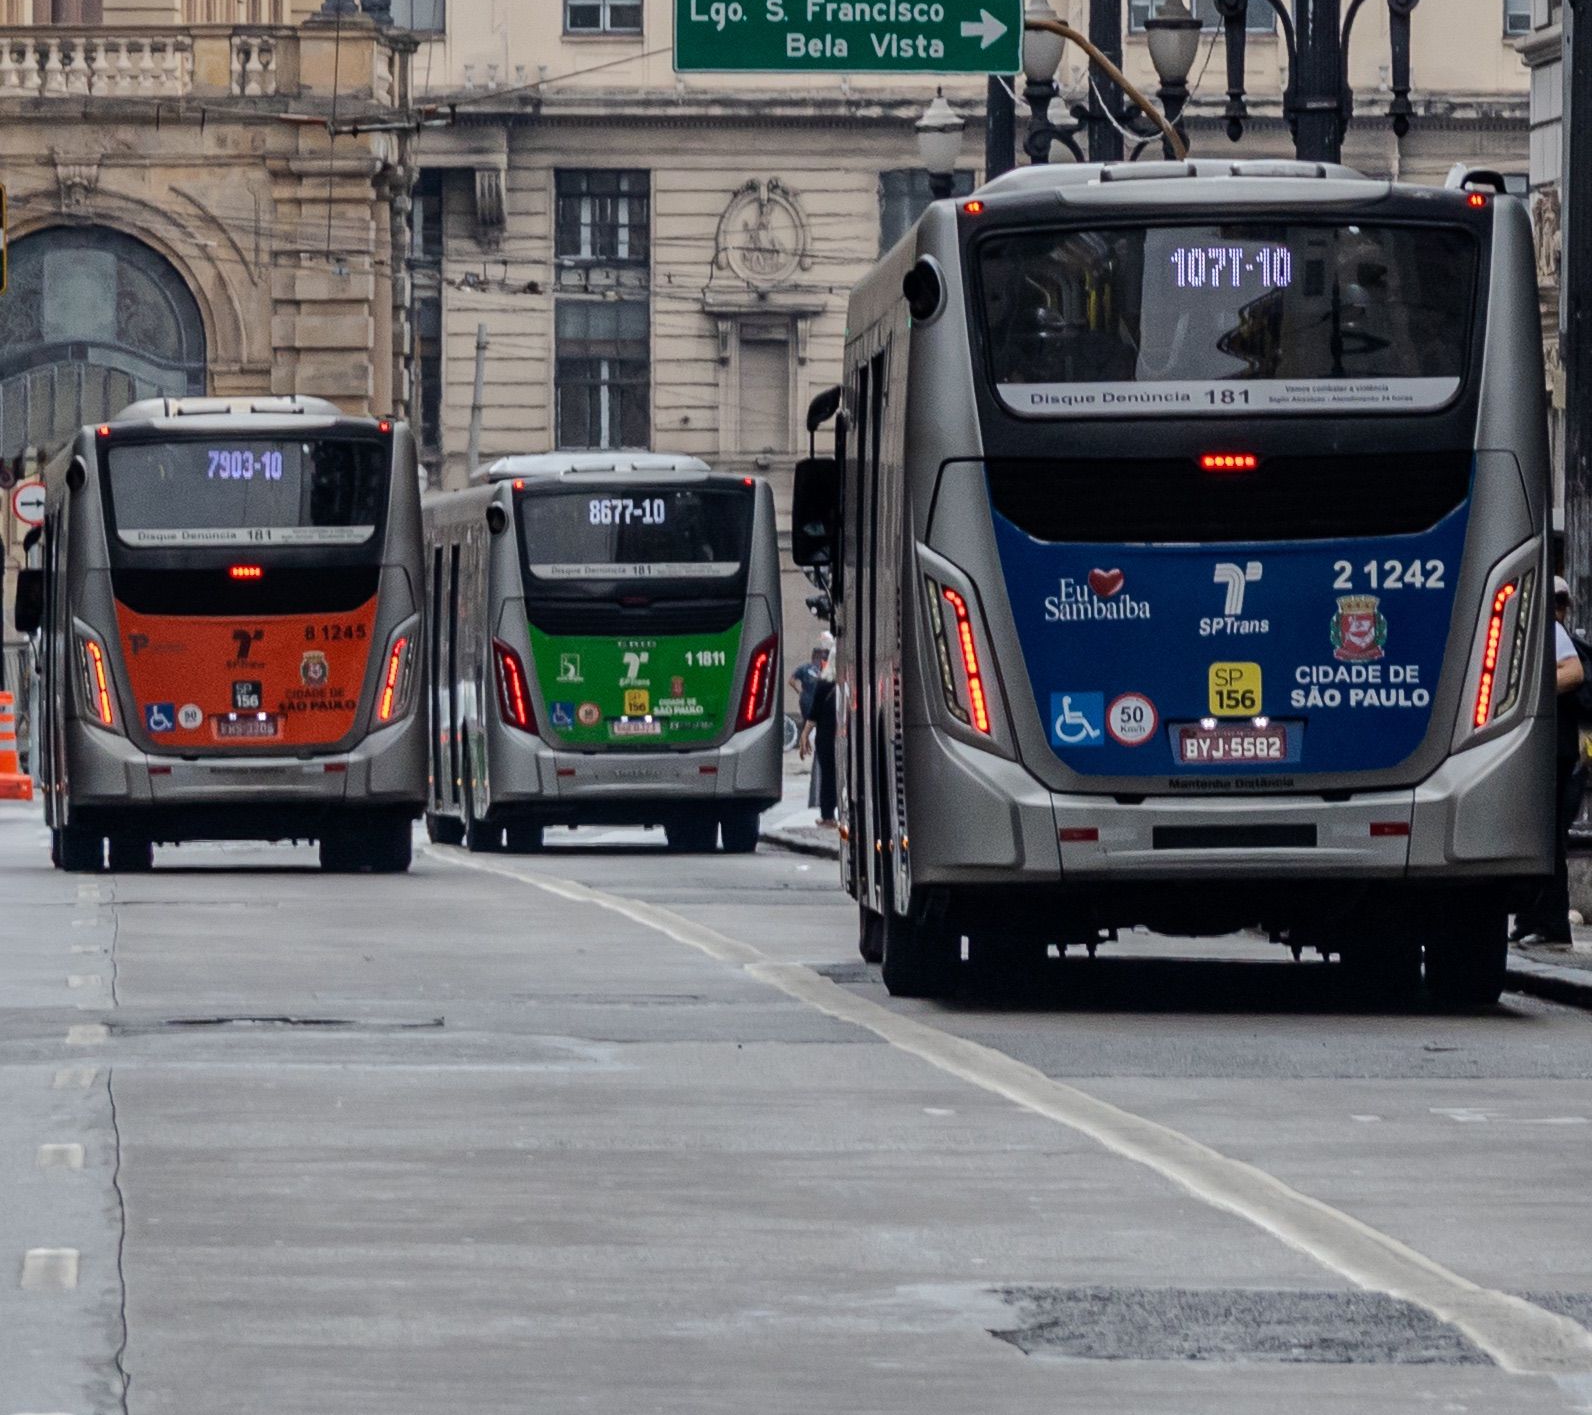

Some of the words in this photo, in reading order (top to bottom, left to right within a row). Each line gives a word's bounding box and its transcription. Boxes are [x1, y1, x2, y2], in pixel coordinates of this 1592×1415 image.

[786, 33, 848, 57] Bela
[870, 33, 945, 57] Vista
[1170, 247, 1291, 287] 107T-10
[1030, 392, 1096, 406] Disque
[1102, 390, 1191, 404] Denúncia
[1205, 389, 1251, 404] 181
[207, 450, 283, 480] 7903-10
[589, 498, 666, 525] 8677-10
[137, 531, 178, 543] Disque
[247, 529, 272, 541] 181
[633, 565, 652, 575] 181
[1333, 560, 1353, 589] 2
[1363, 559, 1445, 589] 1242
[1060, 578, 1089, 602] Eu
[1045, 594, 1150, 622] Sambaíba
[1199, 616, 1269, 635] SPTrans
[1215, 668, 1243, 687] SP
[1295, 665, 1382, 684] CIDADE
[1389, 665, 1420, 684] DE
[236, 694, 259, 708] 156
[1216, 689, 1256, 709] 156
[1290, 686, 1342, 708] SÃO
[1350, 688, 1430, 707] PAULO
[1120, 706, 1144, 723] 50
